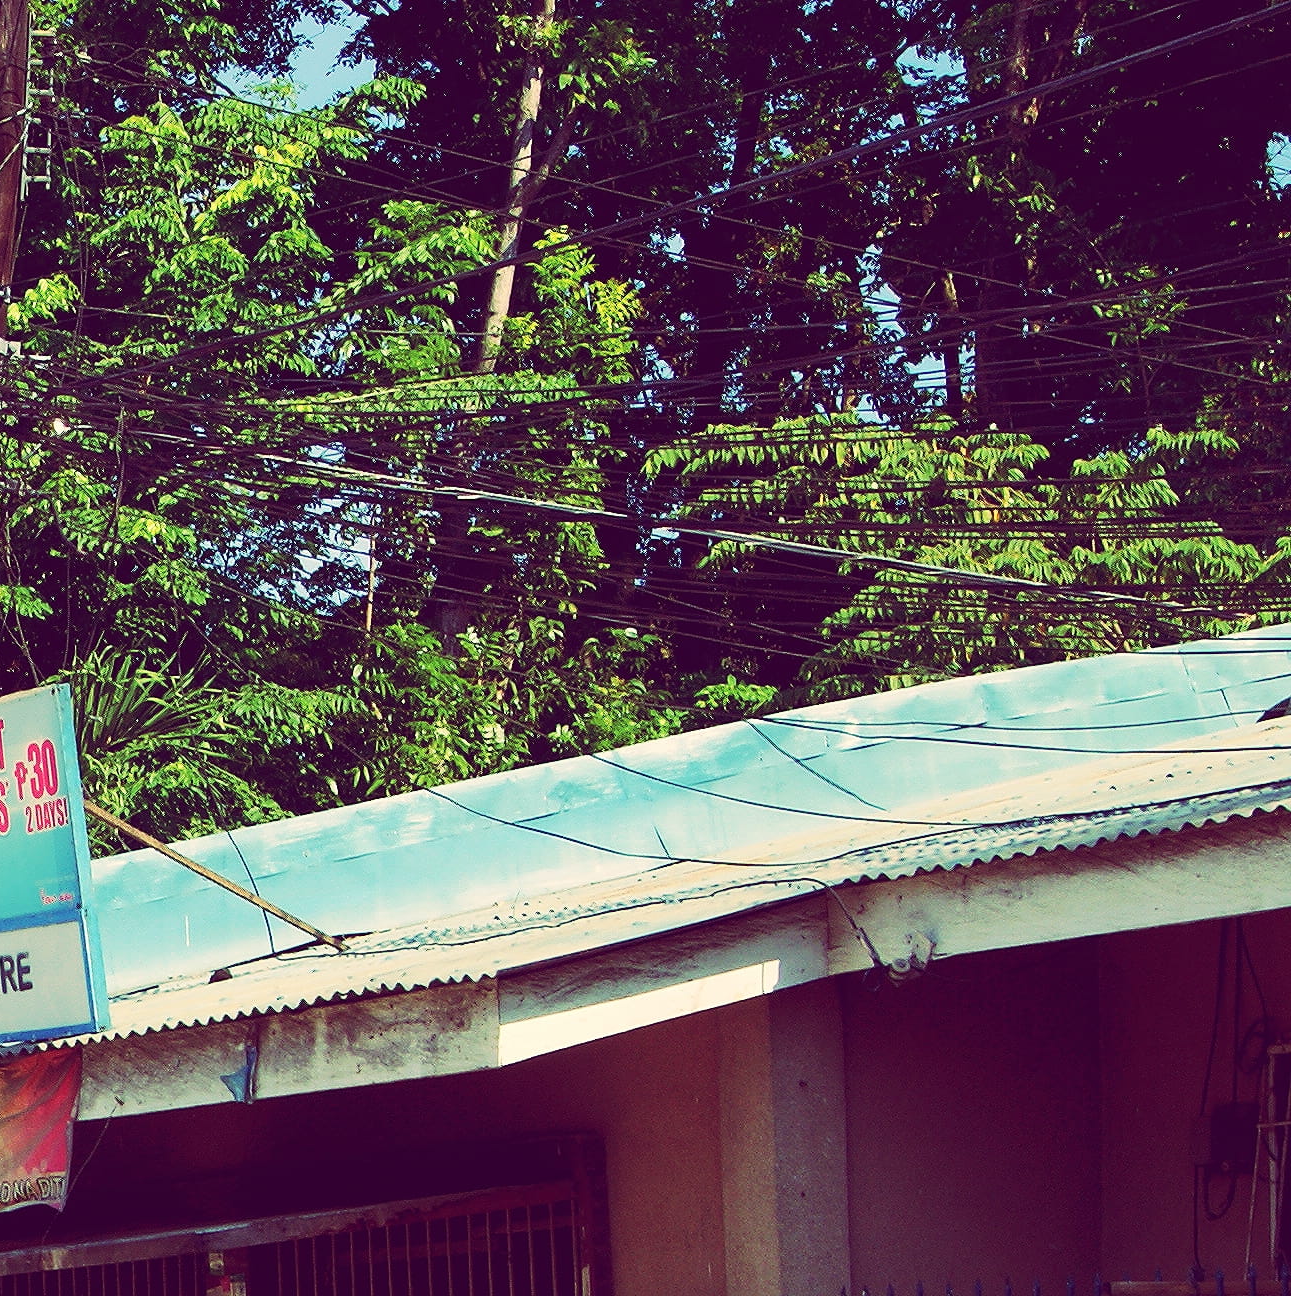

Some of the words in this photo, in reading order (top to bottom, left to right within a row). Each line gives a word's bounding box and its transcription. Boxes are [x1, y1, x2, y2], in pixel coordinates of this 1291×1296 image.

[25, 806, 35, 833] 2
[36, 798, 70, 831] DAYS!
[36, 1175, 66, 1201] DIT
